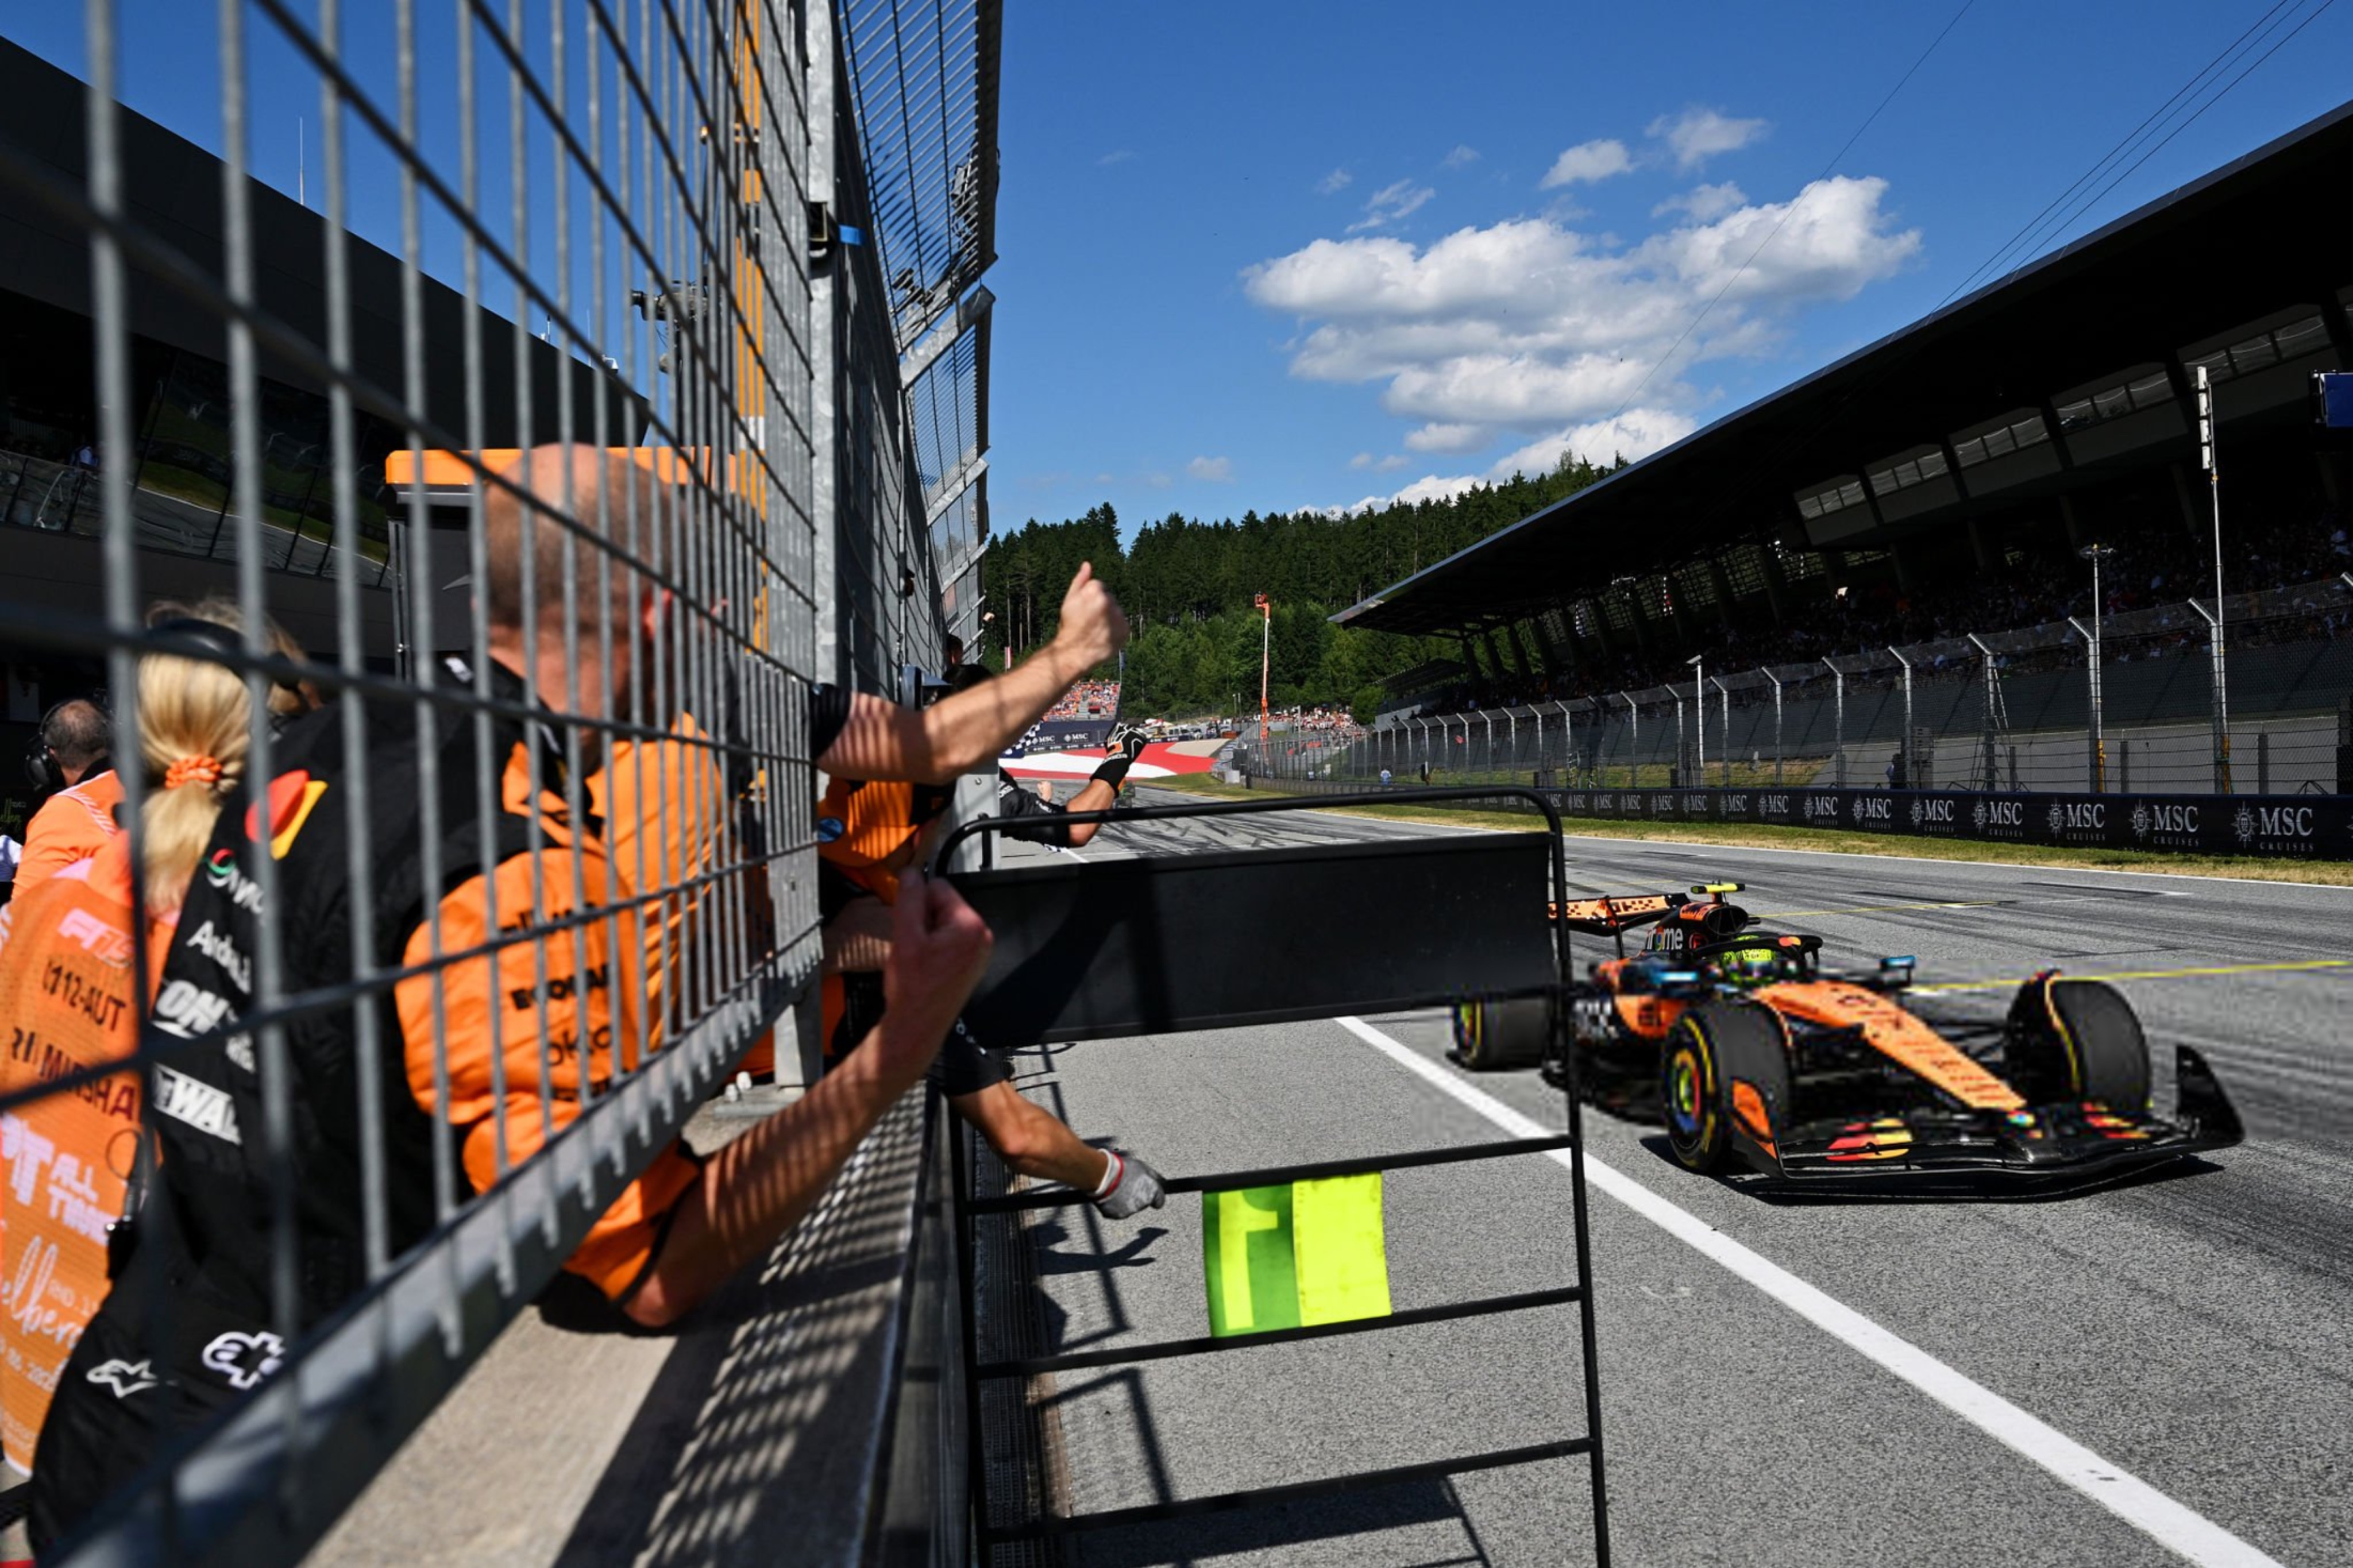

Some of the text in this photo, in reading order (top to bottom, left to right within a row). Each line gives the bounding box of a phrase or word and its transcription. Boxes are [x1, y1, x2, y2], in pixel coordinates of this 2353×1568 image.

[1573, 795, 1586, 809] MSC
[1599, 795, 1613, 809] MSC
[1627, 795, 1641, 810] MSC
[1658, 795, 1673, 810] MSC
[1691, 795, 1708, 811] MSC
[1727, 795, 1747, 812] MSC
[1768, 795, 1789, 813] MSC
[1815, 797, 1838, 816] MSC
[1865, 798, 1892, 818] MSC
[1925, 800, 1954, 821] MSC
[1989, 801, 2023, 825] MSC
[2066, 804, 2105, 828] MSC
[2153, 805, 2199, 832] MSC
[2259, 806, 2313, 836] MSC
[2066, 832, 2106, 841] CRUISES
[2153, 836, 2200, 846] CRUISES
[2259, 842, 2315, 852] CRUISES
